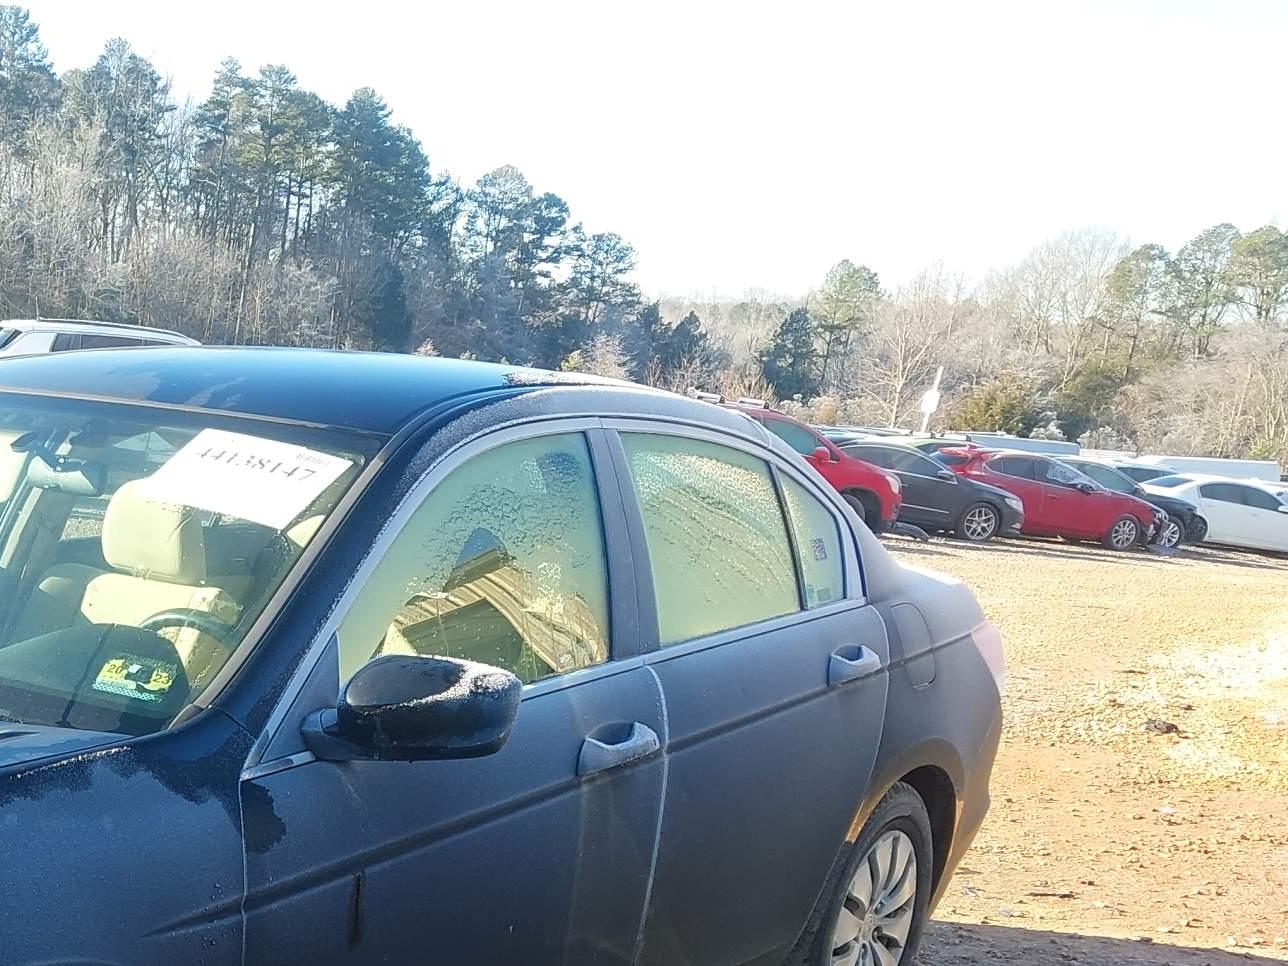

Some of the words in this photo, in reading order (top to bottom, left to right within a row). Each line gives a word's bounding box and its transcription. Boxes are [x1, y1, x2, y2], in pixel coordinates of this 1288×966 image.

[196, 447, 318, 481] 44138147
[107, 663, 124, 675] 20
[152, 673, 170, 685] 23
